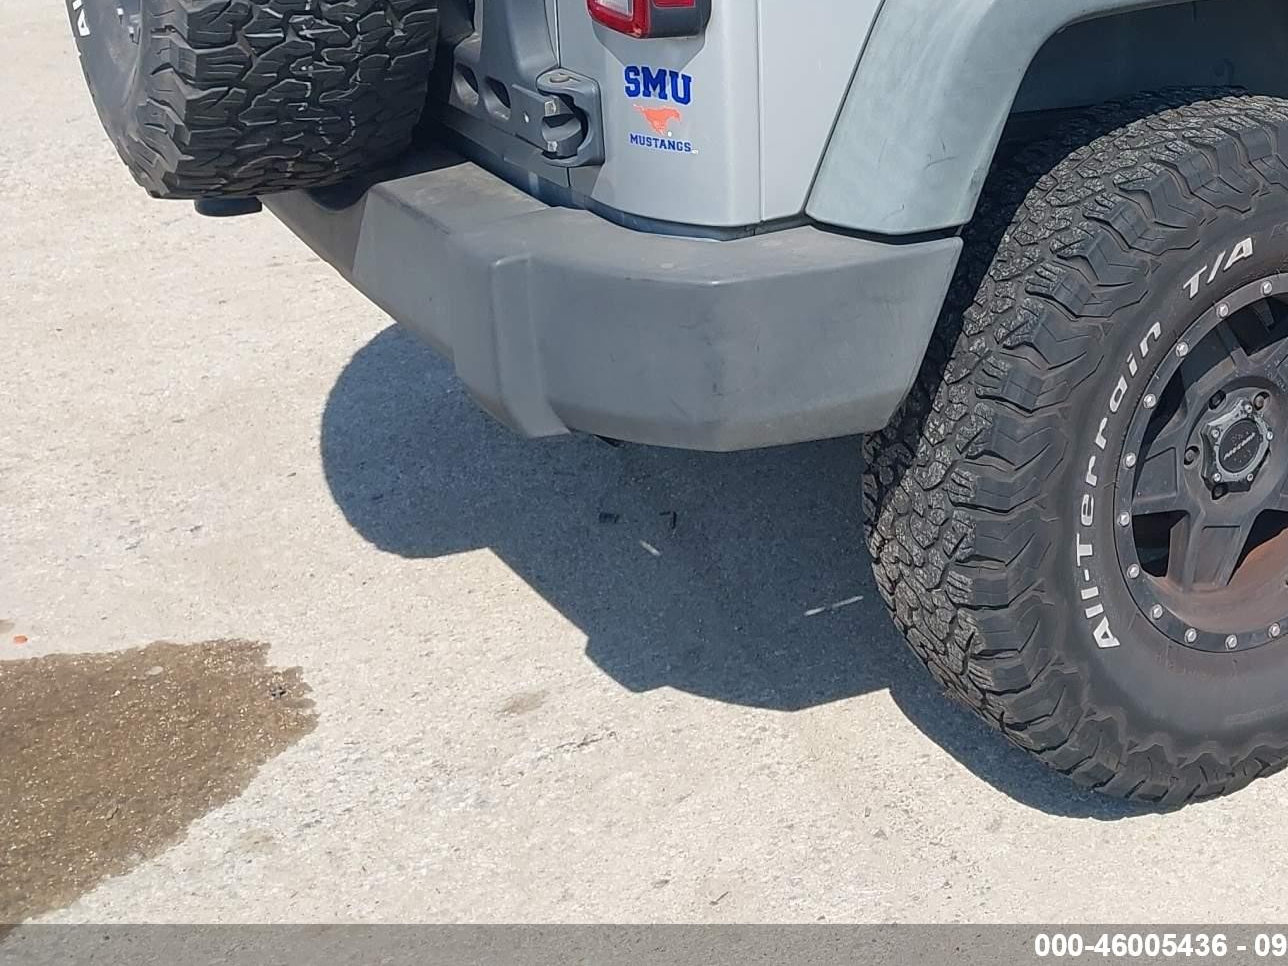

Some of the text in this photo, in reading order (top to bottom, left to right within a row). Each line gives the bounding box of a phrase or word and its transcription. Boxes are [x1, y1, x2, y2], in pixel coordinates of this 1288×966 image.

[624, 65, 692, 105] SMU
[630, 133, 692, 152] MUSTANGS
[1183, 237, 1255, 299] T/A
[1076, 321, 1162, 649] All-Terrain
